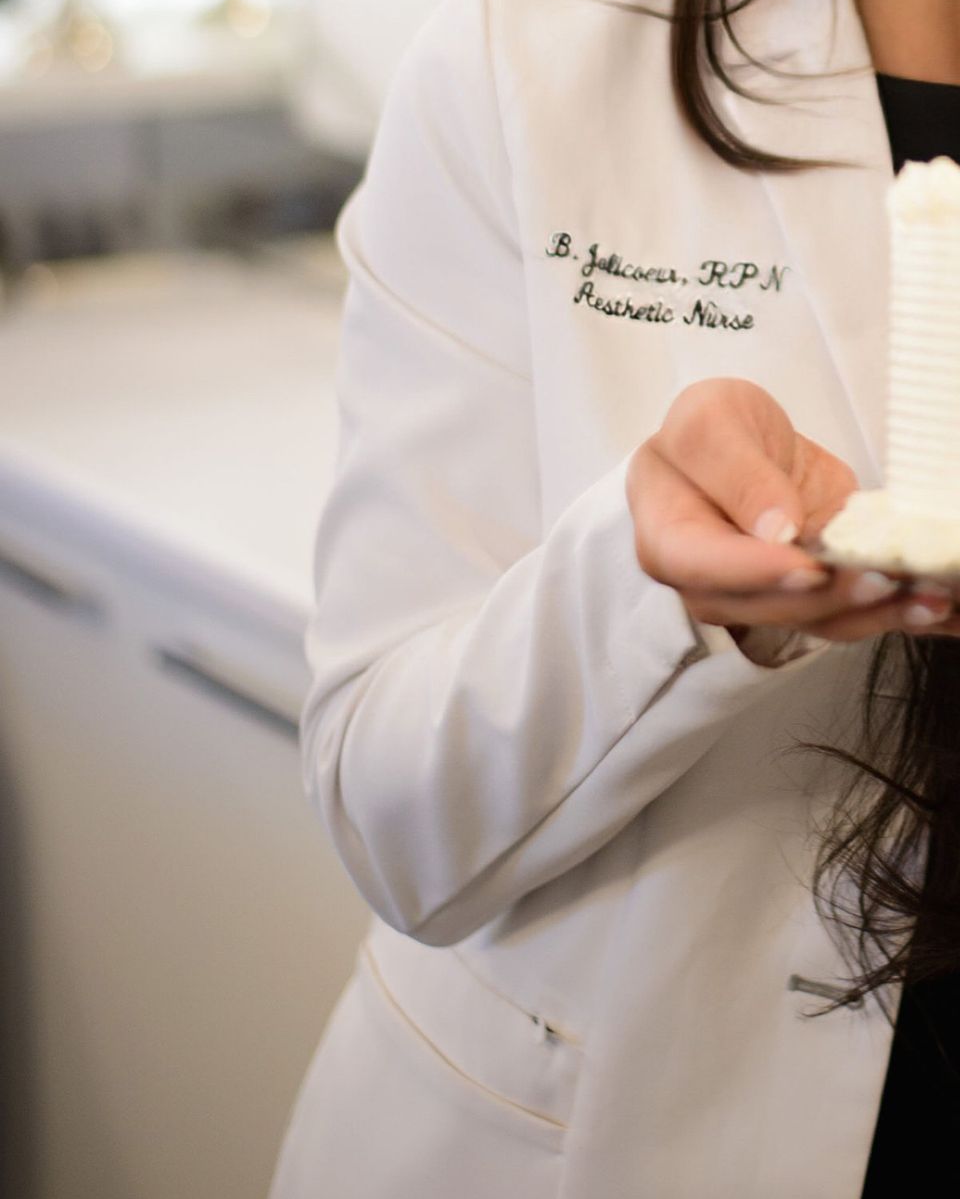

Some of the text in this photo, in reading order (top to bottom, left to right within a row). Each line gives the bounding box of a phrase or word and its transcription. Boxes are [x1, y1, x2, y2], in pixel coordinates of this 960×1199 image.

[546, 231, 578, 260] B.
[573, 281, 755, 331] Aesthetic Nurse
